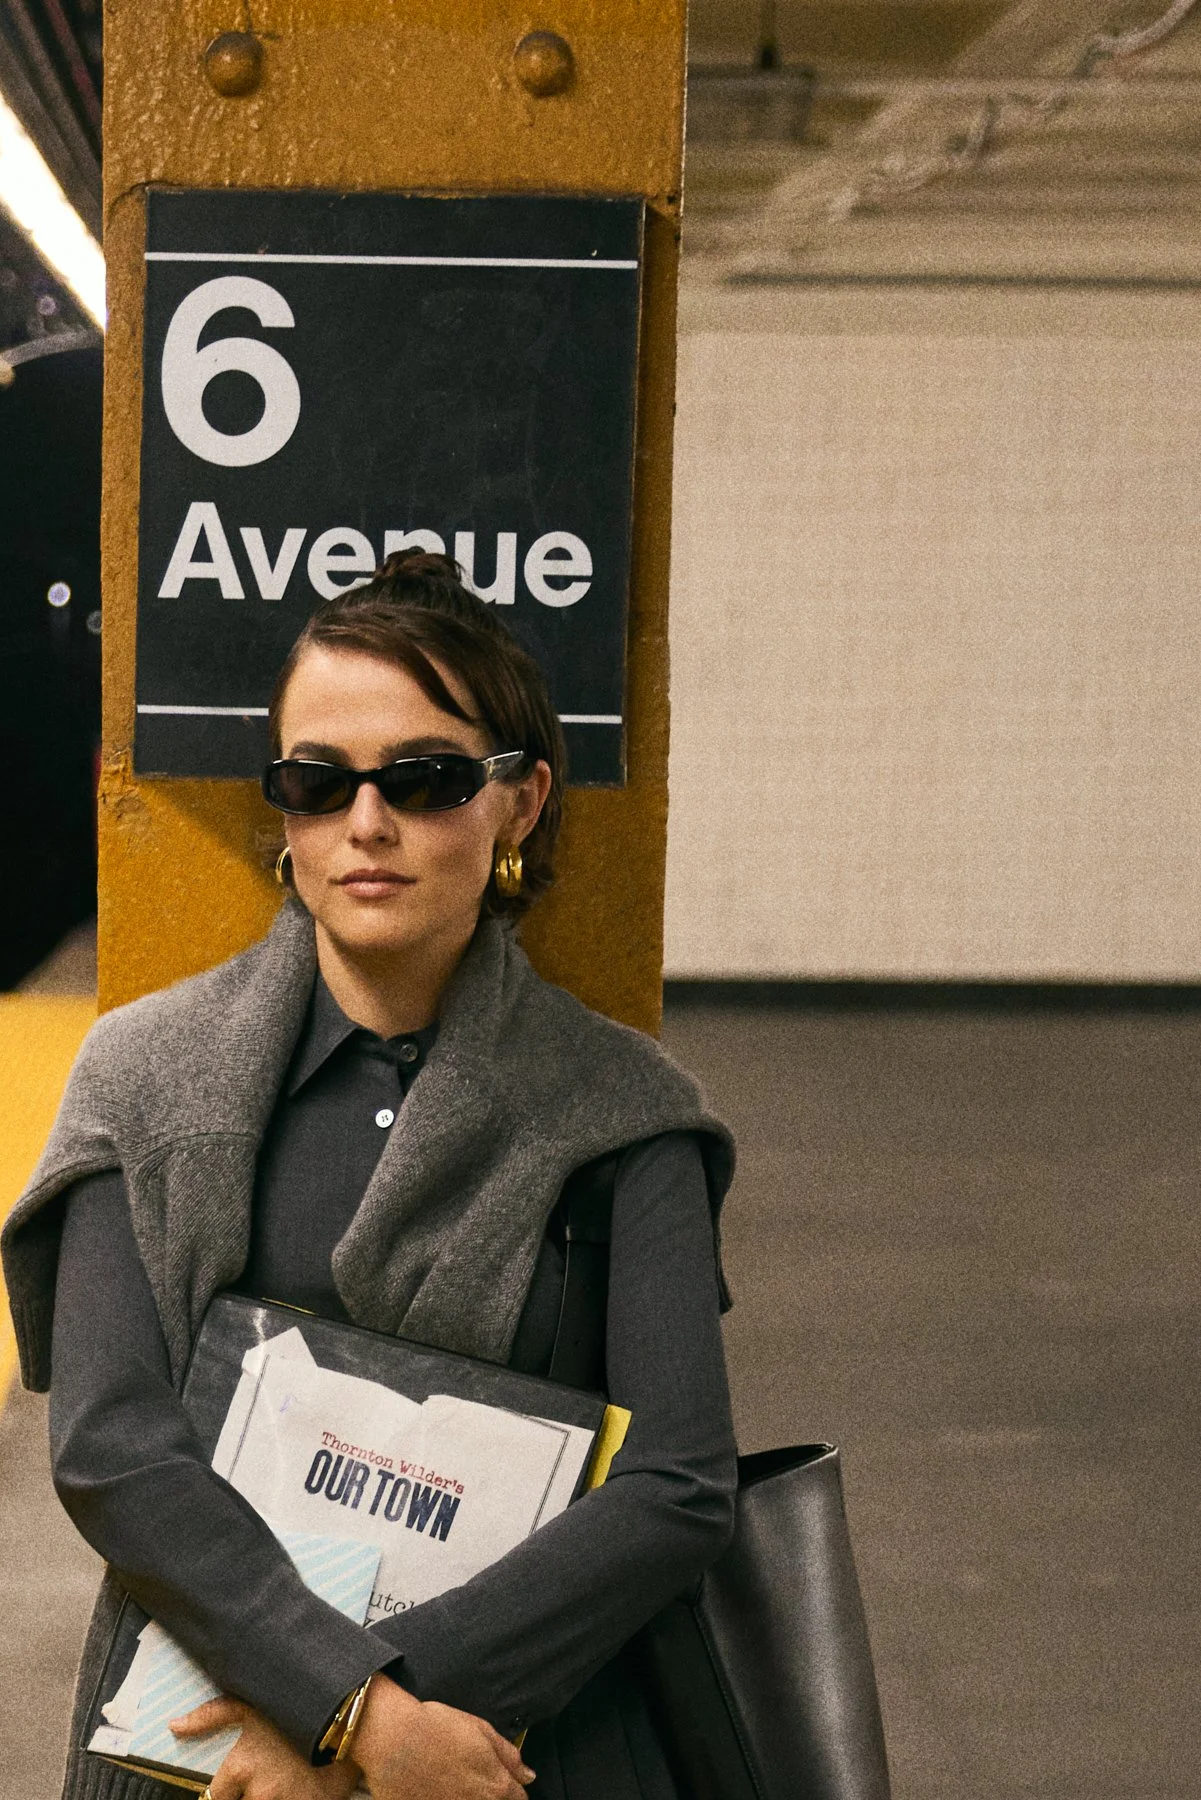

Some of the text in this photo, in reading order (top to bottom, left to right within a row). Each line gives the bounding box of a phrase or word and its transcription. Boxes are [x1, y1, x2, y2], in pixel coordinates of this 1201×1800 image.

[161, 275, 301, 467] 6
[304, 1449, 461, 1542] OUR TOWN
[321, 1431, 465, 1495] Thornton Wilder's
